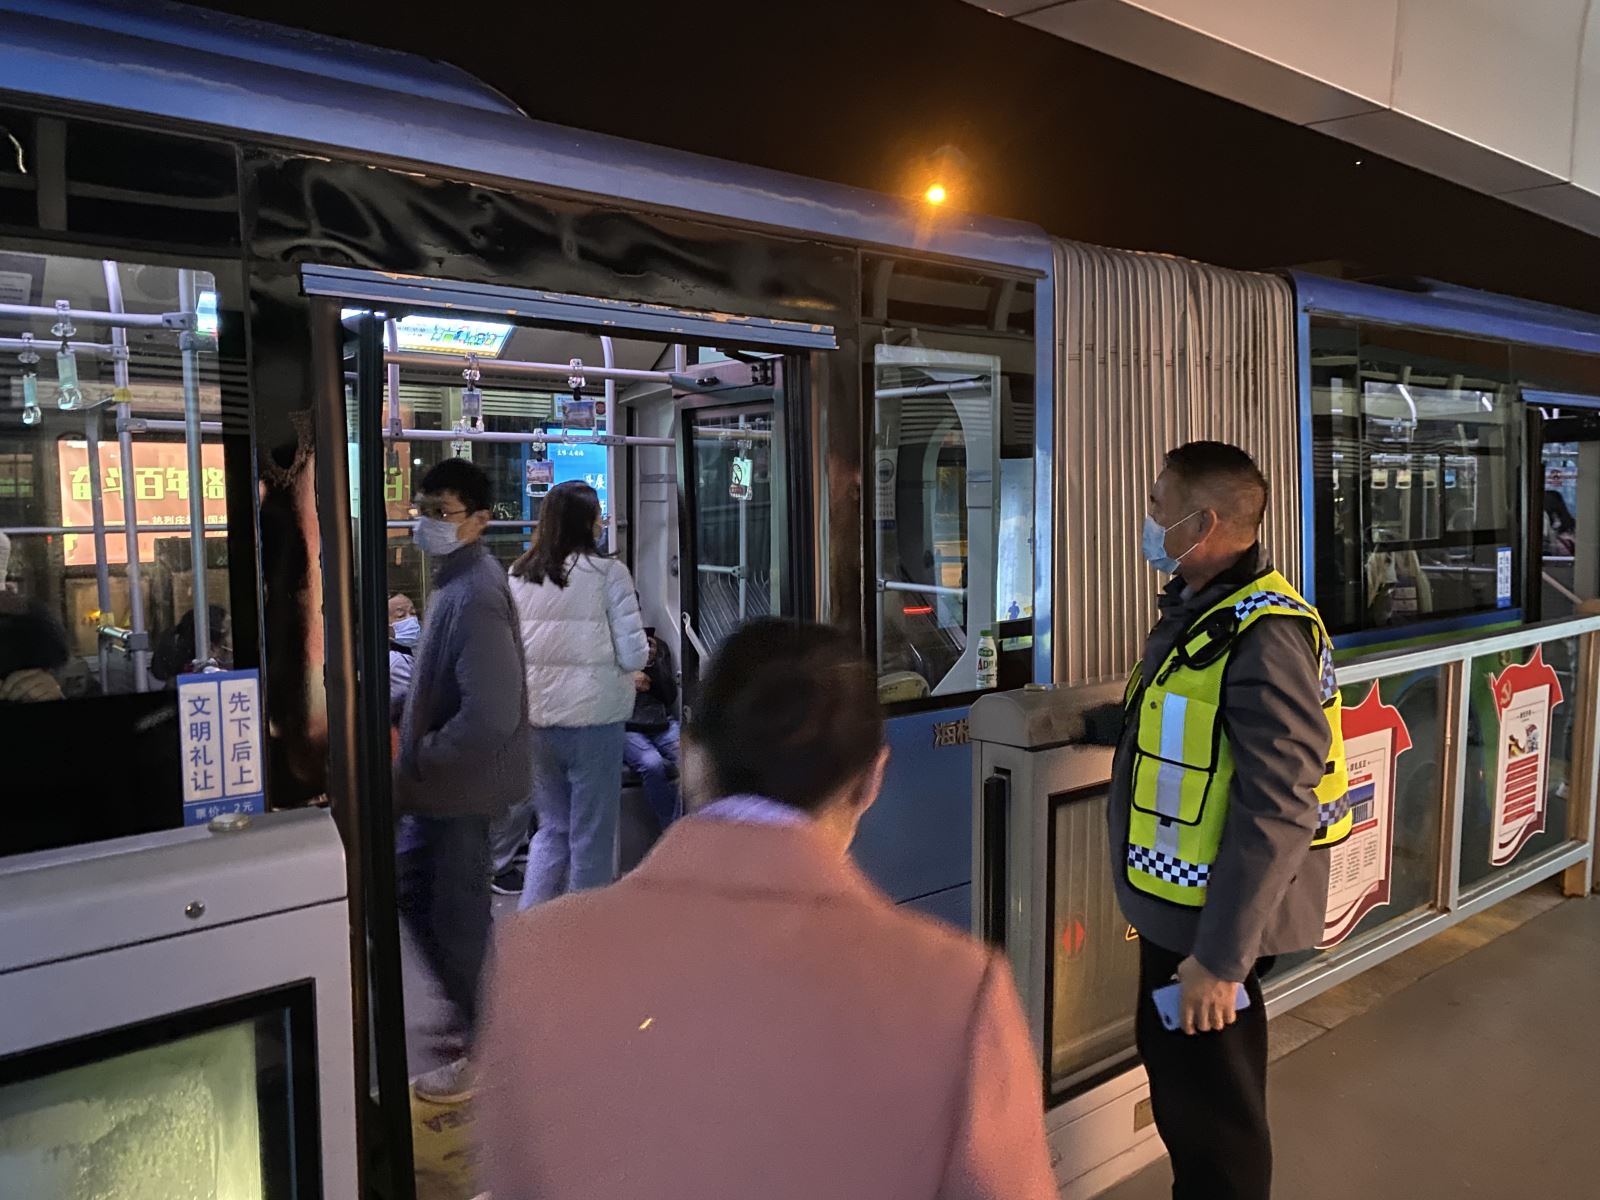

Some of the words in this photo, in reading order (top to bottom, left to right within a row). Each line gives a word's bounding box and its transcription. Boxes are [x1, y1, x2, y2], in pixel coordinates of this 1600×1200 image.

[188, 695, 214, 791] 文明礼让
[229, 691, 254, 786] 先下后上
